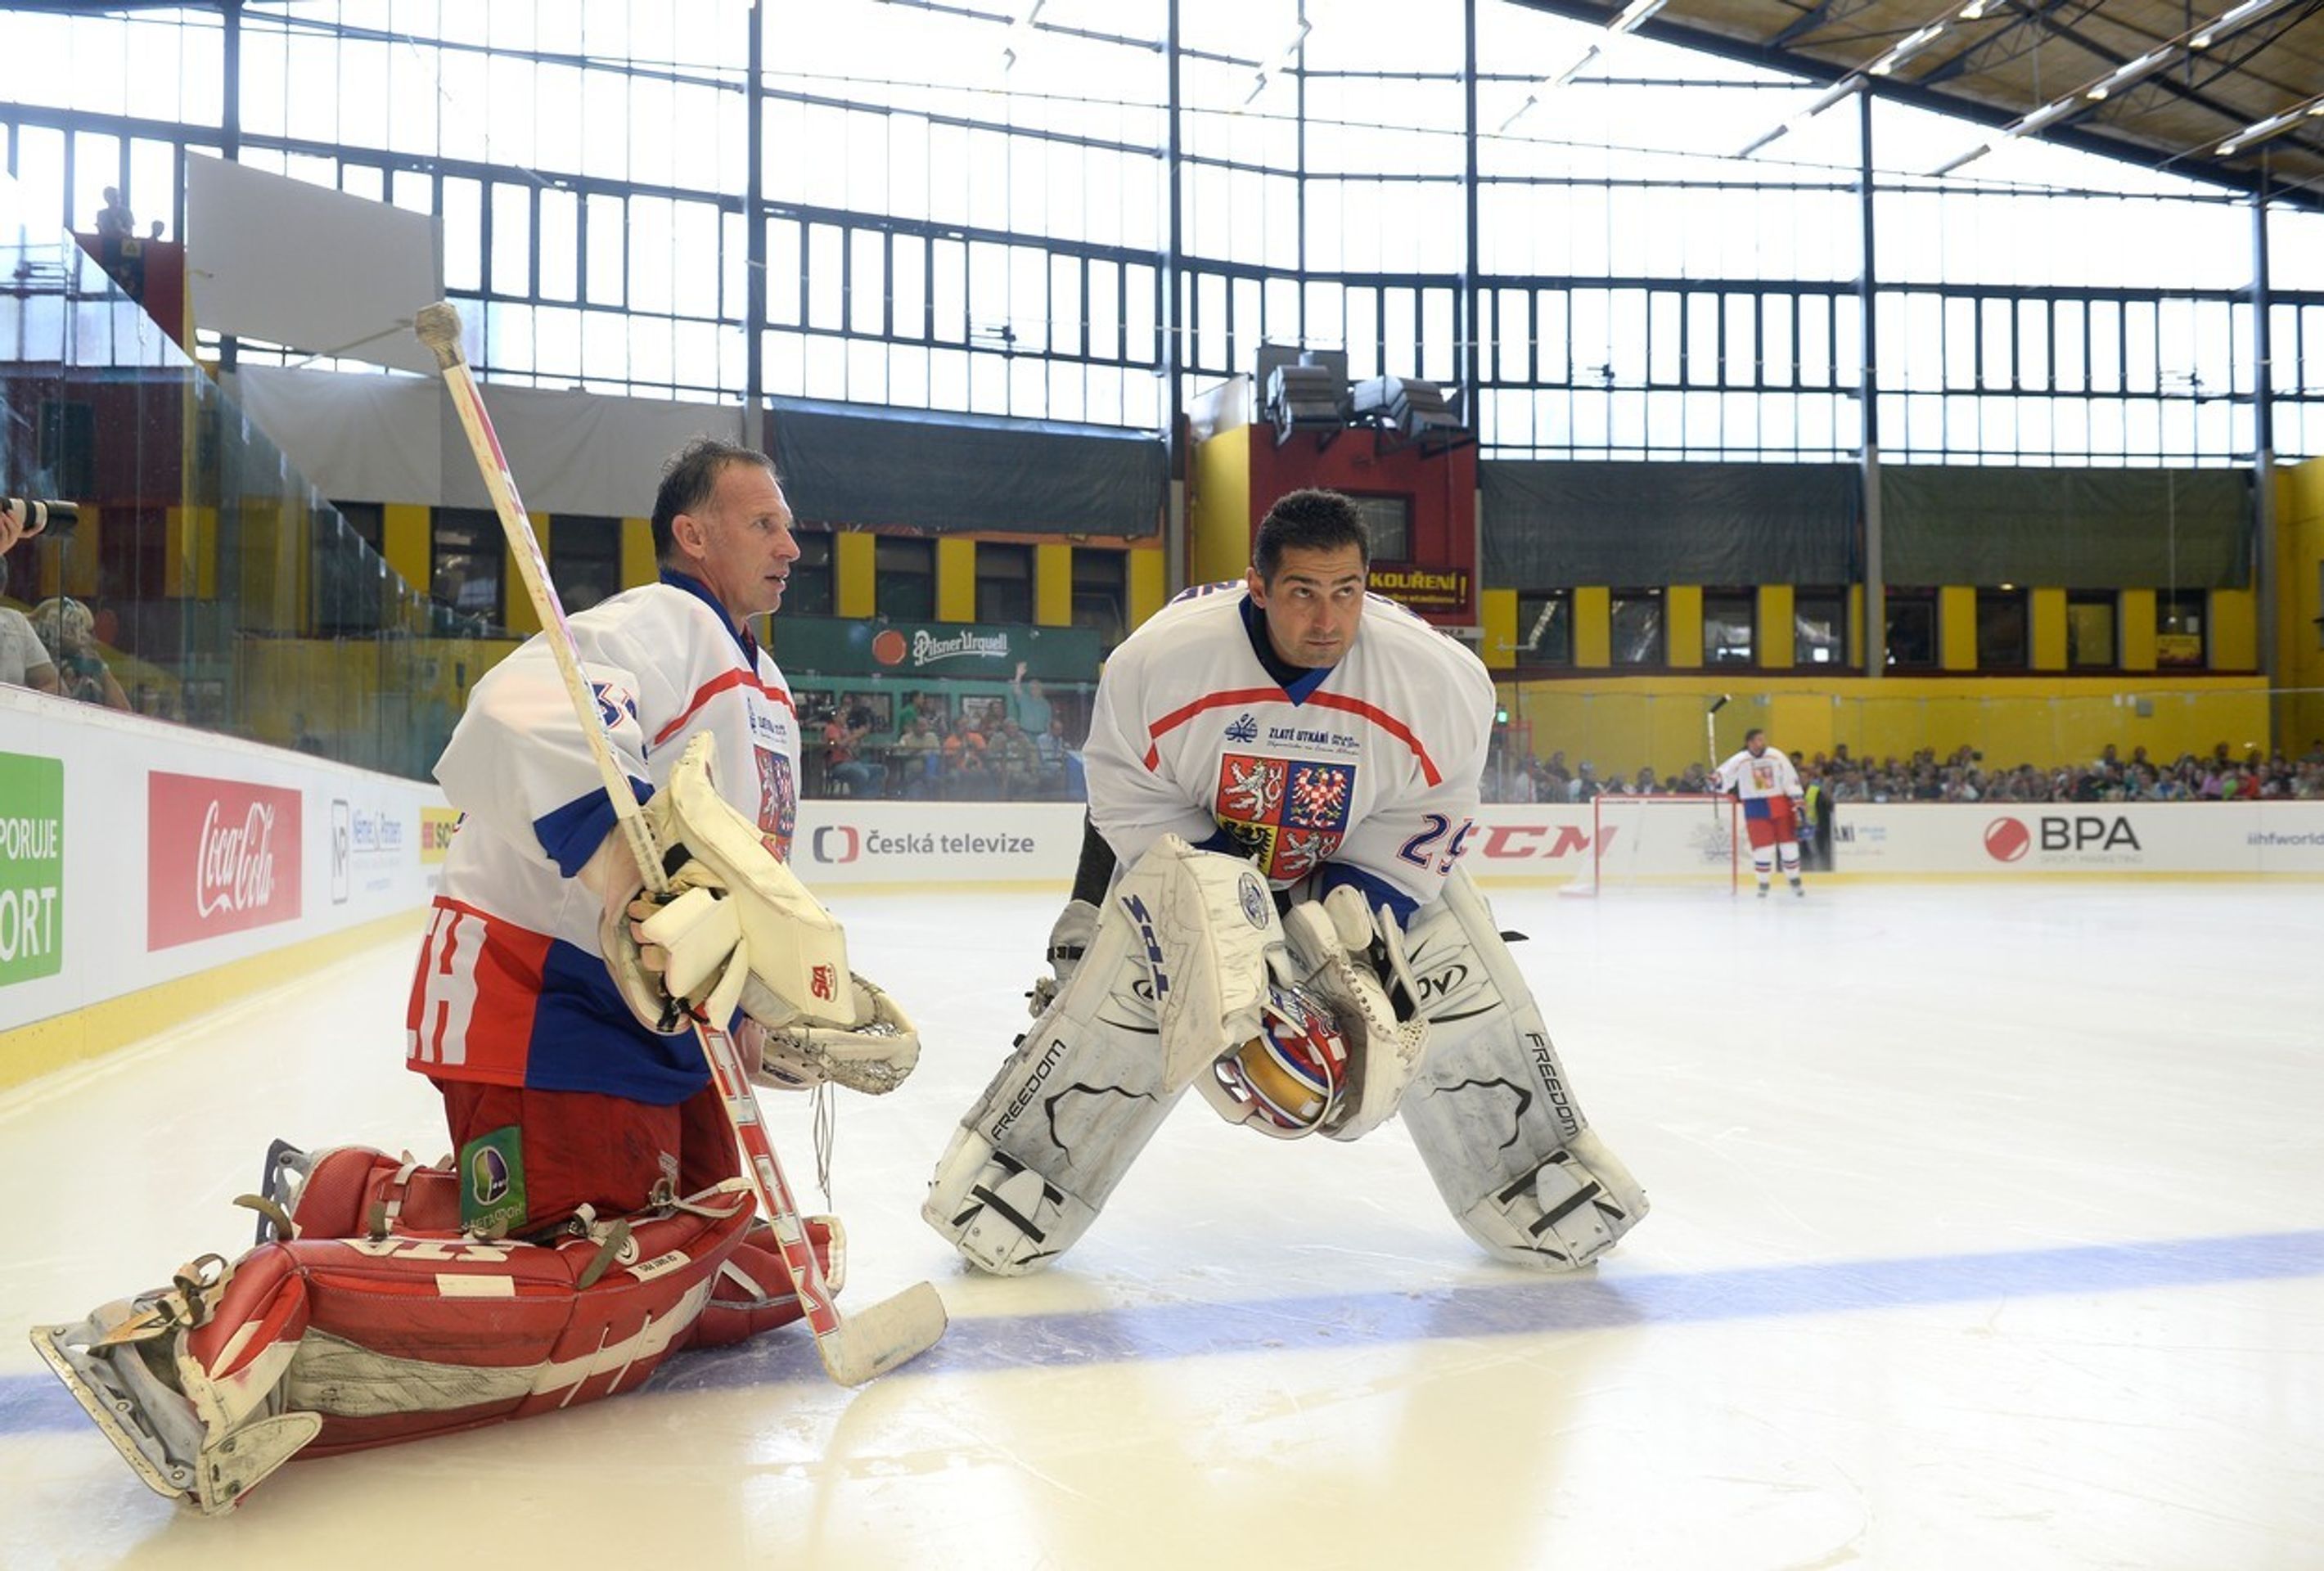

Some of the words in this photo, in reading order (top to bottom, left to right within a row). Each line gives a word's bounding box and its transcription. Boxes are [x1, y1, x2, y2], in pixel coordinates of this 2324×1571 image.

[1370, 570, 1456, 590] KOUŘENÍ
[913, 630, 962, 666] Pilsner
[961, 630, 1007, 658] Urquell
[1269, 727, 1295, 740] ZLATÉ
[1296, 729, 1329, 743] UTKÁNÍ
[436, 822, 455, 849] SC
[867, 830, 934, 853] Česká
[941, 834, 1034, 853] televize
[1466, 825, 1619, 858] CM
[2041, 817, 2141, 850] BPA
[409, 908, 489, 1065] H
[991, 1039, 1066, 1141] FREEDOM
[1525, 1033, 1579, 1137] FREEDOM
